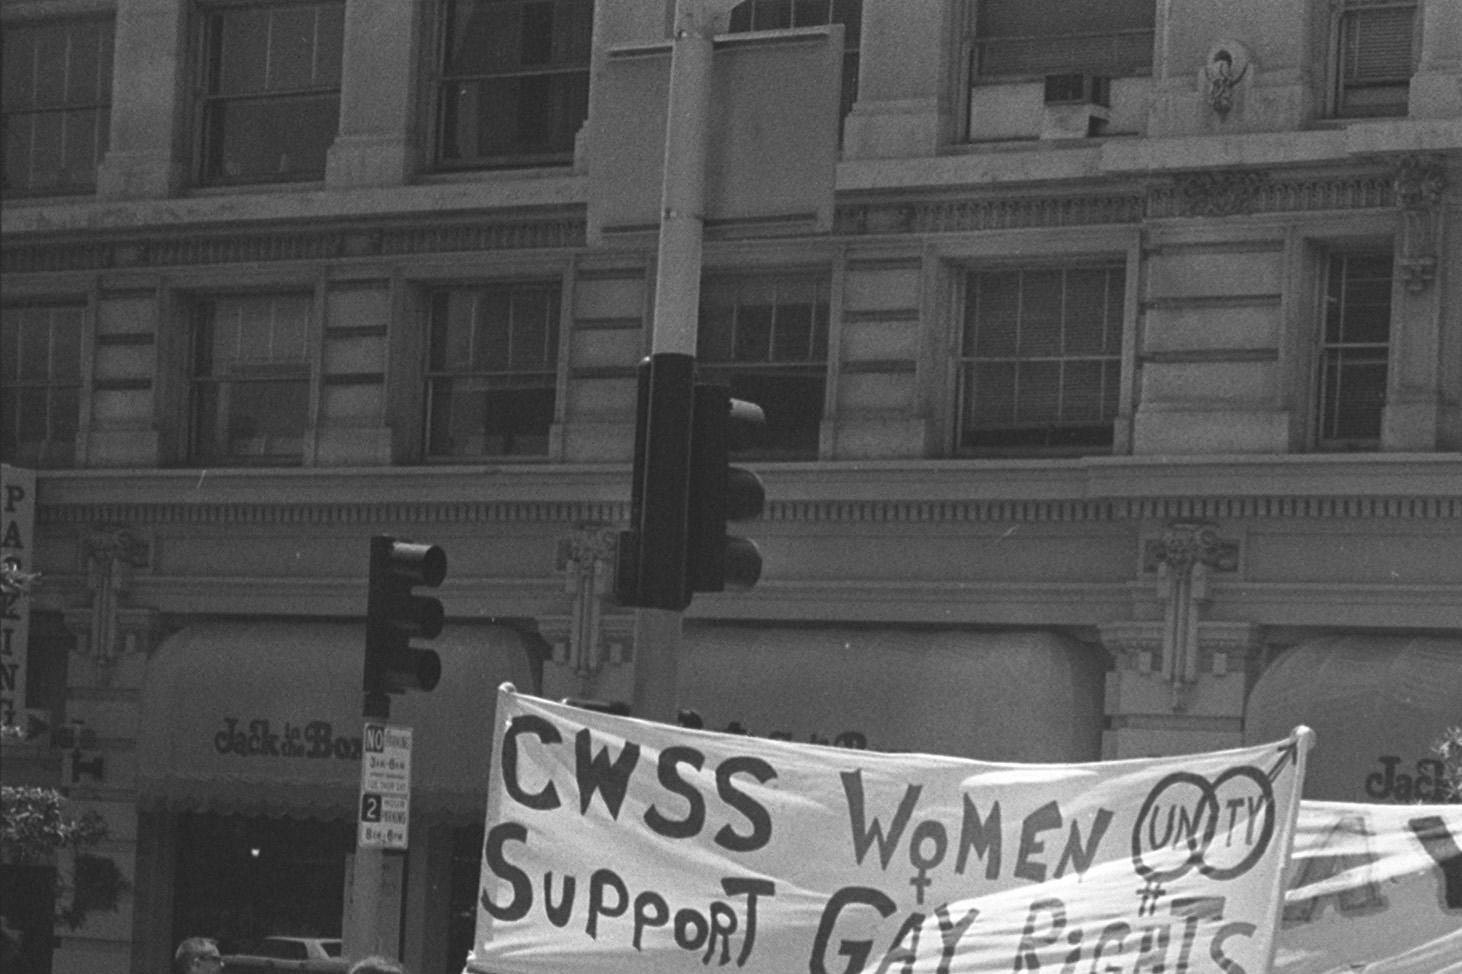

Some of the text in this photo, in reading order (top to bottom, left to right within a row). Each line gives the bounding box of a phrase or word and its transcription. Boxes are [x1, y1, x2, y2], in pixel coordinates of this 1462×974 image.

[367, 729, 384, 751] NO
[367, 797, 378, 820] 2
[501, 714, 1116, 885] CWSS WOMEN
[481, 823, 777, 967] SUPPORT
